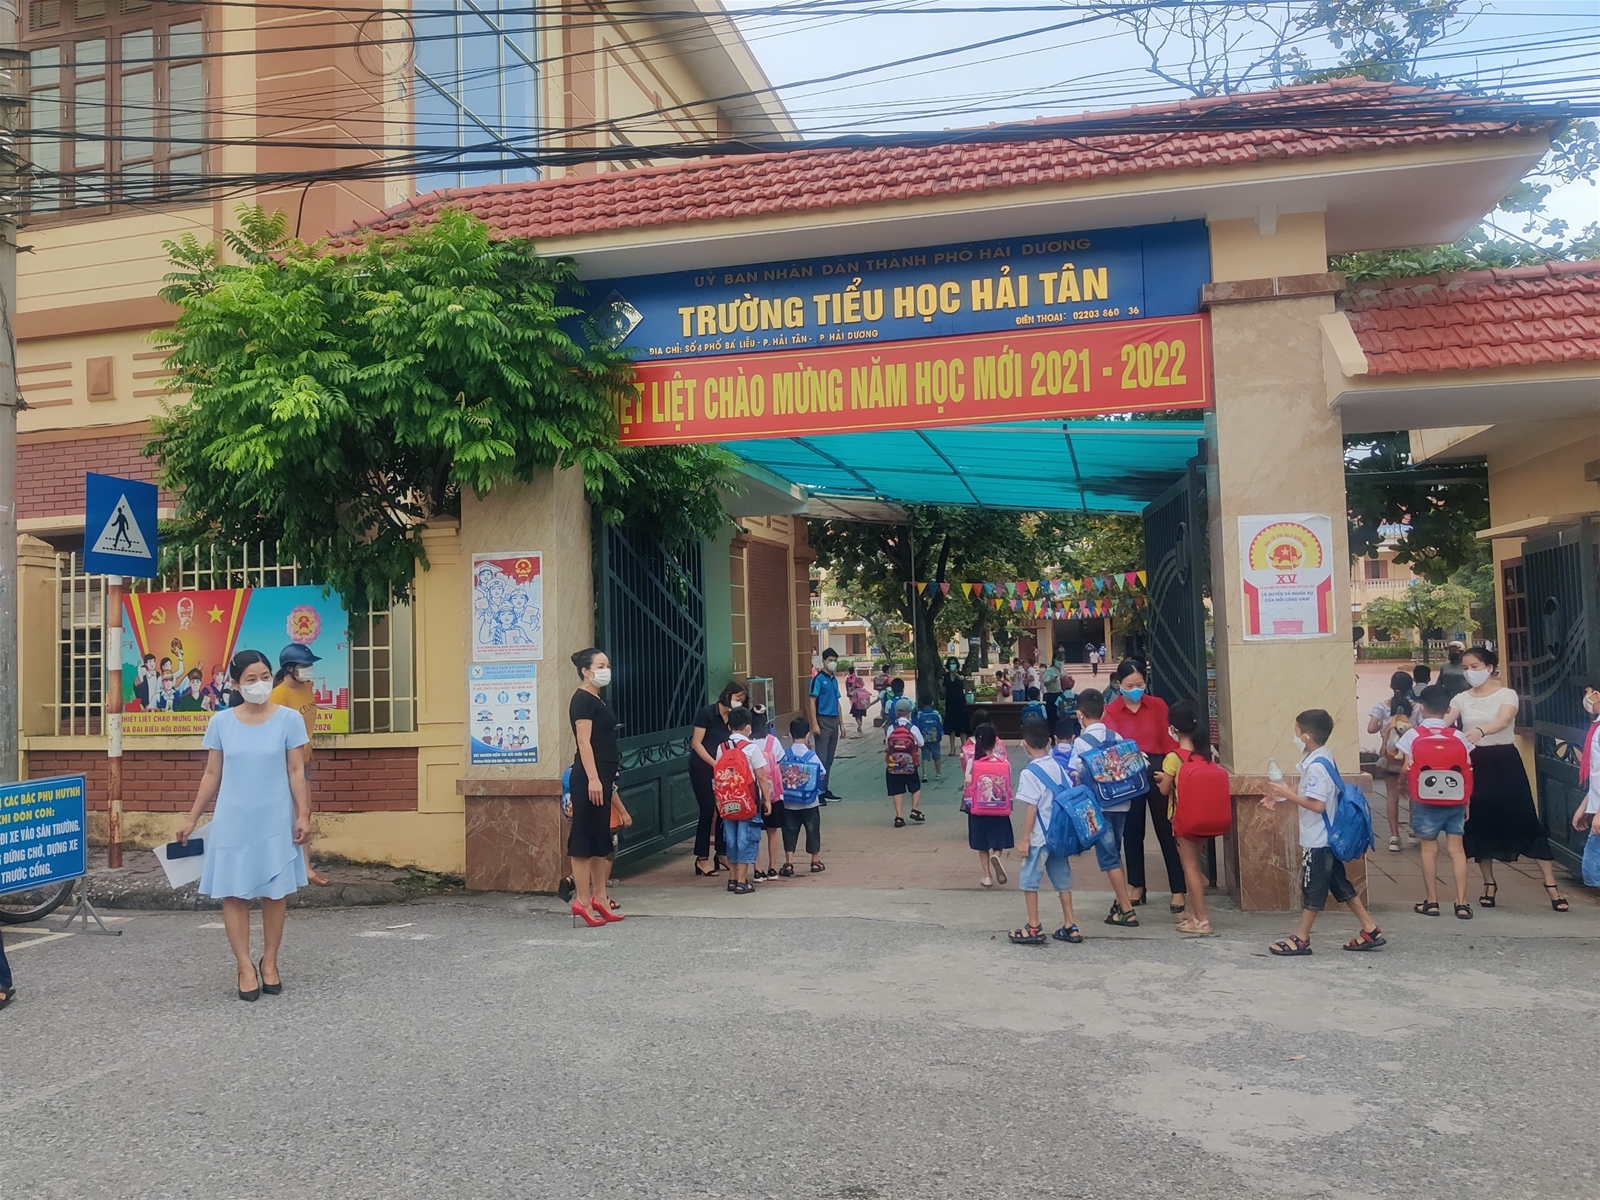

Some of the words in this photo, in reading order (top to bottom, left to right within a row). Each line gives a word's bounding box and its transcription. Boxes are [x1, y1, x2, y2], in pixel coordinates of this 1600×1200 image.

[724, 271, 758, 285] BAN
[763, 263, 813, 282] NHÂN
[866, 251, 927, 271] THÀNH
[934, 242, 973, 264] PHỐ
[1022, 238, 1091, 256] DƯƠNG
[678, 292, 804, 337] TRƯỜNG
[813, 277, 884, 325] TIỂU
[894, 281, 961, 323] HỌC
[971, 265, 1029, 312] HẢI
[1038, 262, 1108, 305] TÂN
[1072, 309, 1100, 320] 02203
[1102, 307, 1120, 317] 860
[1128, 306, 1140, 315] 36
[704, 337, 722, 351] PHỐ
[724, 338, 736, 350] BÁ
[763, 338, 771, 347] P.
[772, 333, 788, 346] HẢI
[791, 333, 807, 344] TÂN
[829, 329, 844, 341] HẢI
[847, 329, 879, 340] DƯƠNG
[652, 370, 697, 431] LIỆT
[703, 366, 765, 420] CHÀO
[772, 361, 844, 416] MỪNG
[851, 355, 907, 410] NĂM
[915, 357, 965, 414] HỌC
[973, 344, 1022, 401] MỚI
[1031, 348, 1091, 397] 2021
[1102, 366, 1113, 377] -
[1120, 339, 1188, 390] 2022
[1275, 573, 1298, 585] XV
[314, 723, 332, 731] 2026
[3, 793, 19, 807] CÁC
[37, 790, 54, 803] PHỤ
[55, 786, 80, 800] HUYNH
[13, 809, 33, 823] ĐÓN
[35, 807, 55, 819] CON:
[9, 830, 19, 844] XE
[20, 825, 35, 842] VÀO
[36, 823, 51, 839] SÂN
[52, 818, 81, 836] TRƯỜNG.
[3, 848, 26, 865] ĐỨNG
[27, 843, 45, 860] CHỜ,
[69, 838, 78, 852] XE
[1, 866, 28, 884] TRƯỚC
[29, 860, 53, 878] CỔNG.
